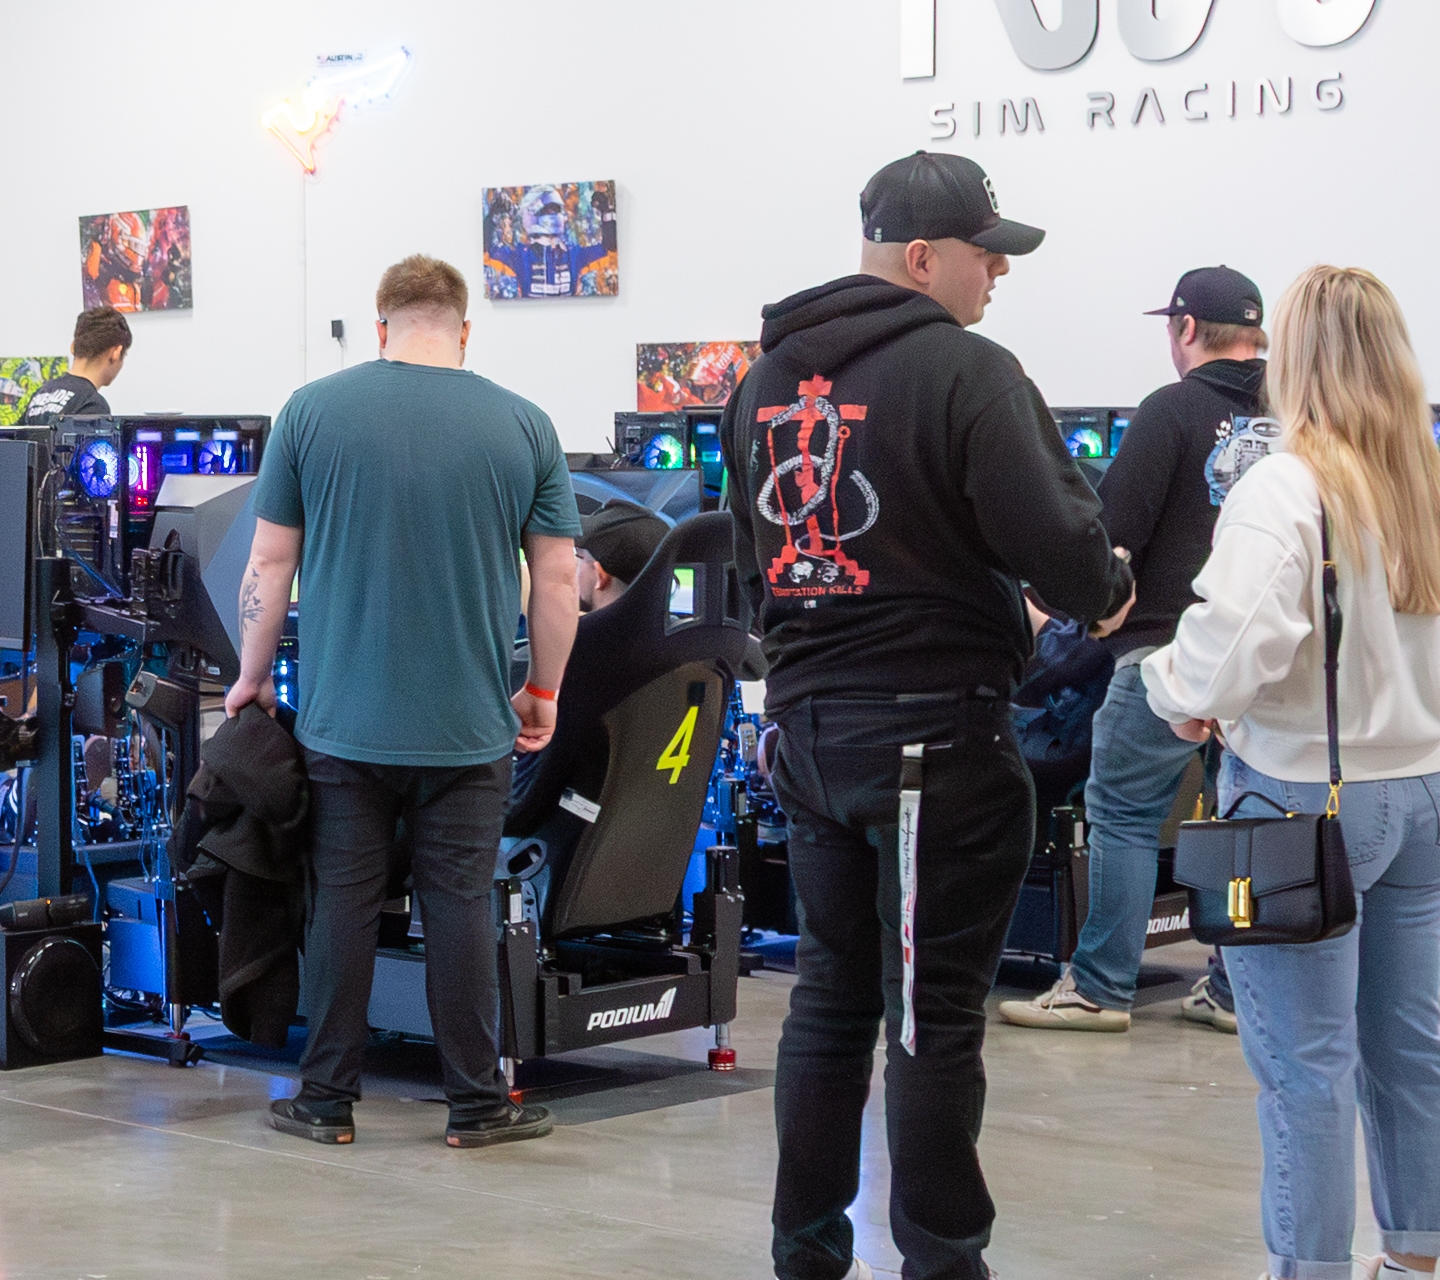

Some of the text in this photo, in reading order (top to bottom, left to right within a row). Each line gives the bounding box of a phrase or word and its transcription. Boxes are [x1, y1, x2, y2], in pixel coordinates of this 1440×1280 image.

[928, 71, 1346, 141] SIM RACING
[828, 585, 864, 595] KILLS
[656, 705, 700, 785] 4
